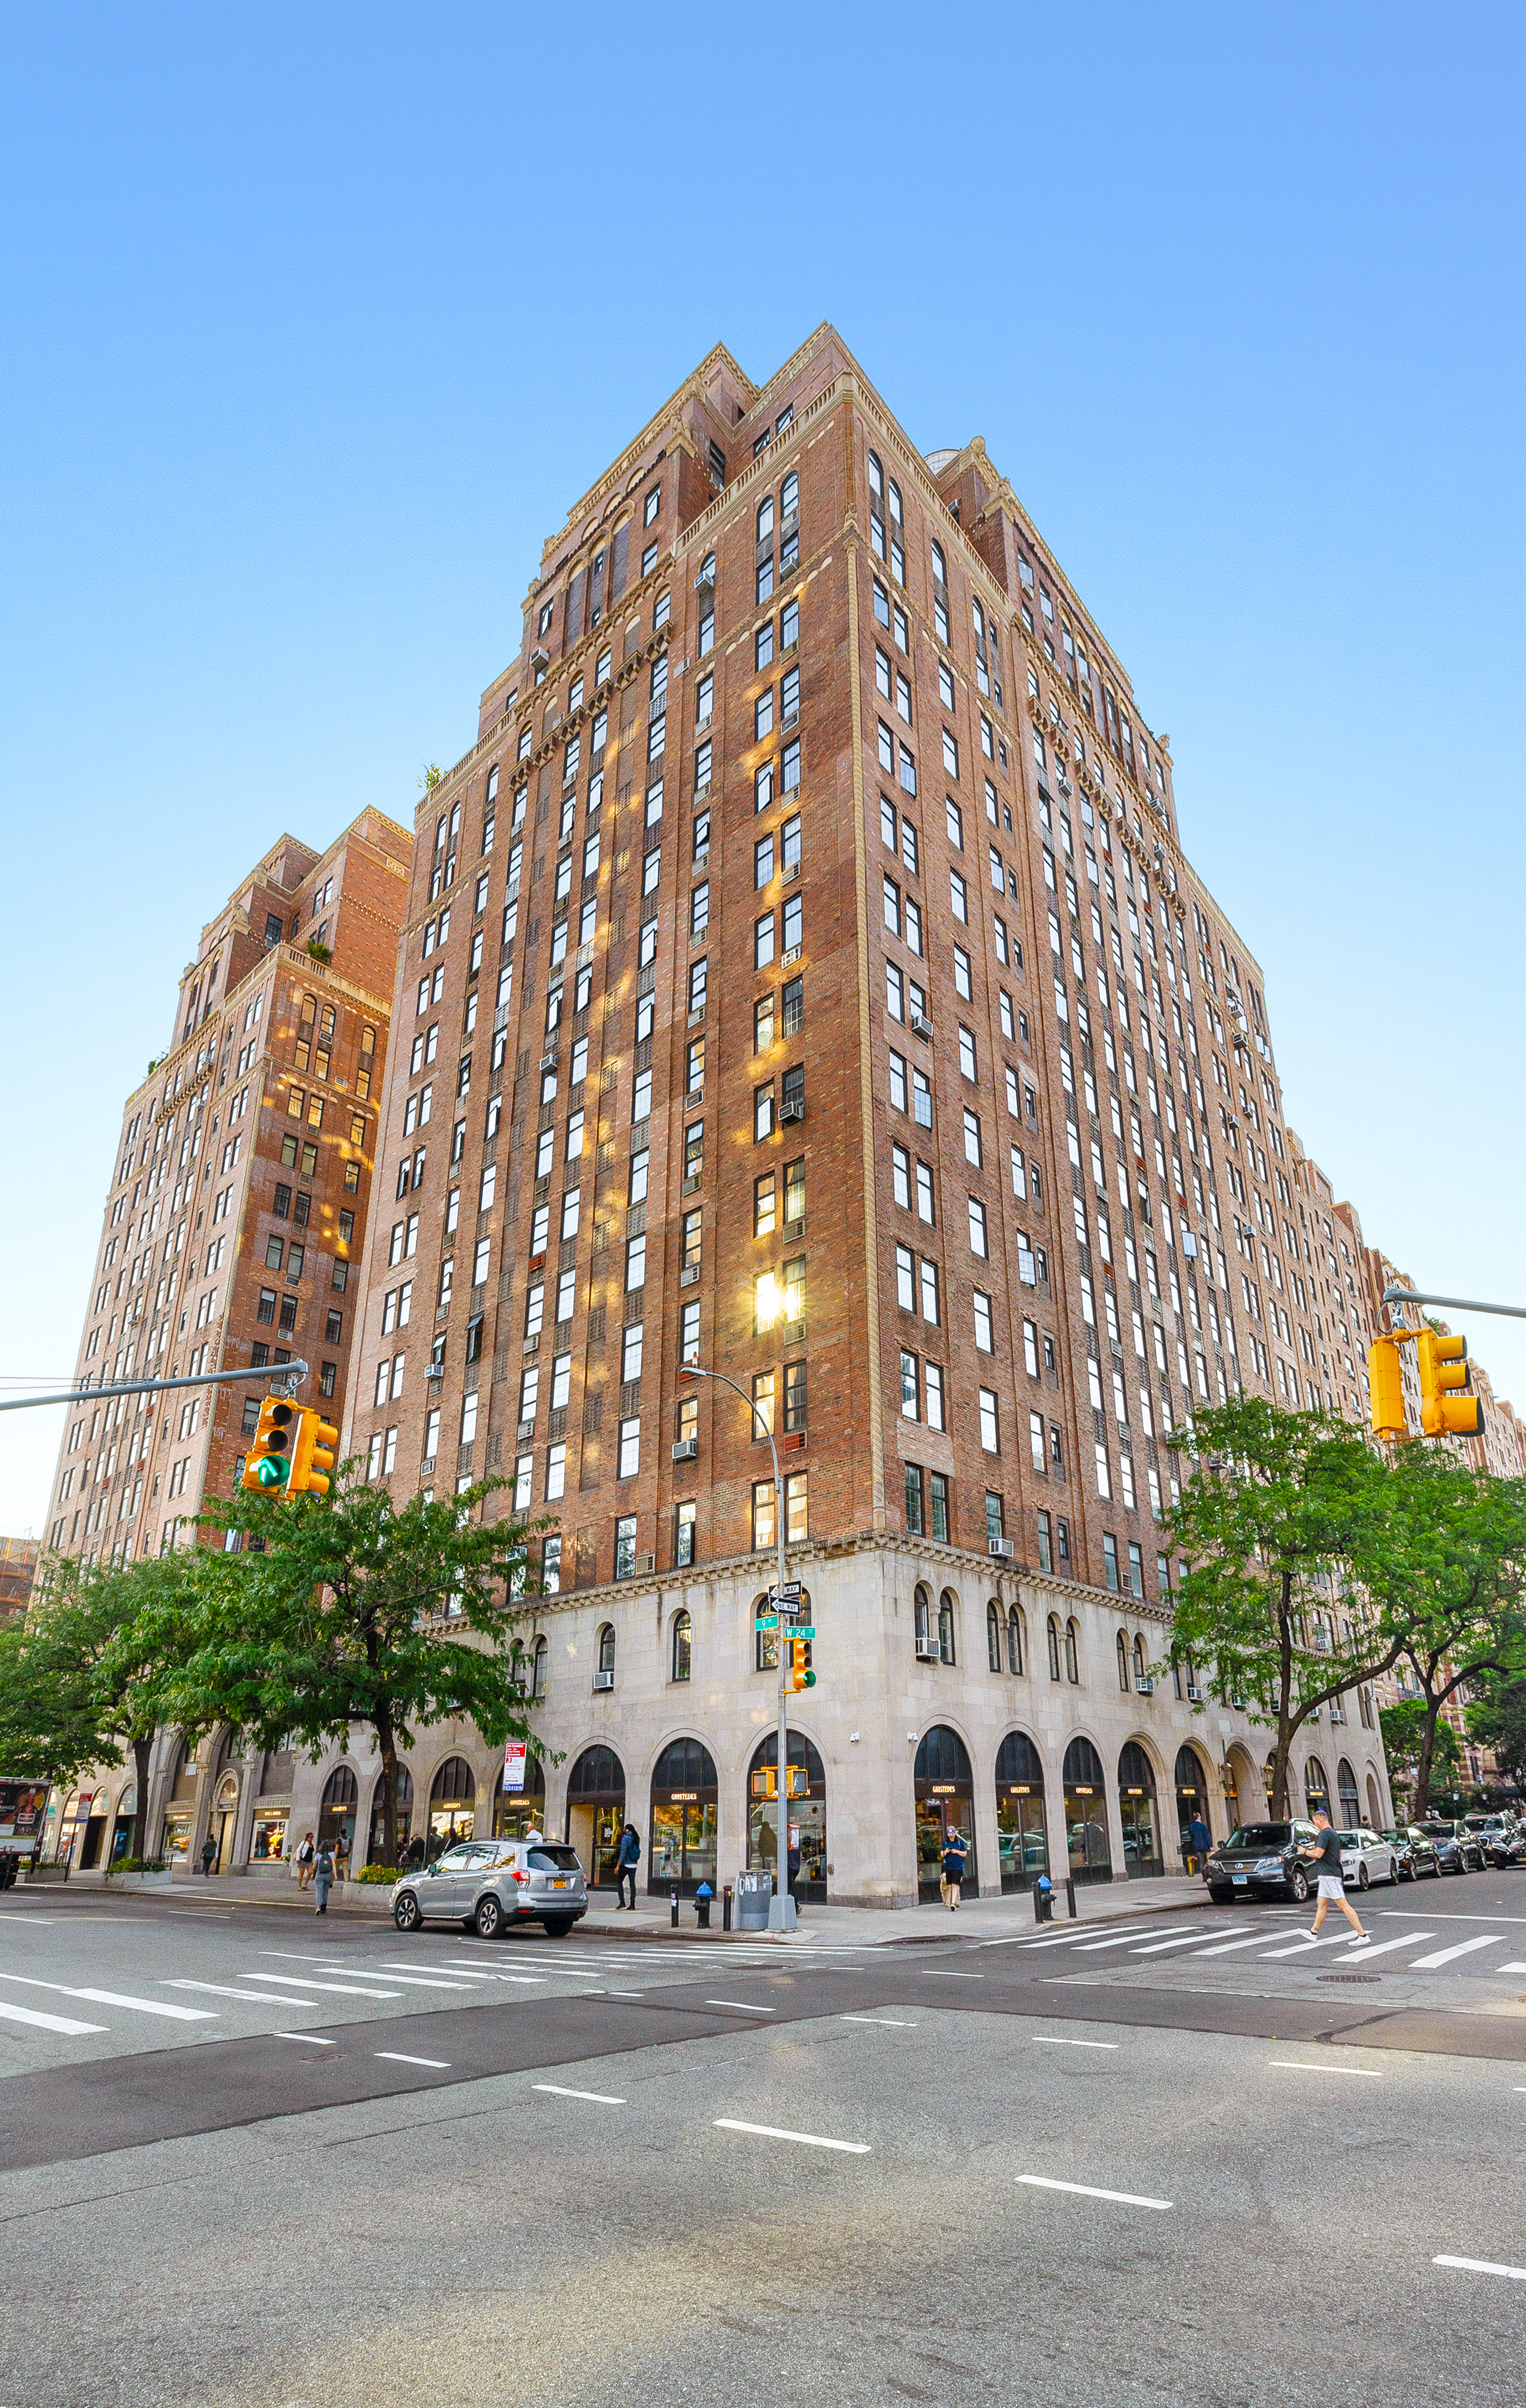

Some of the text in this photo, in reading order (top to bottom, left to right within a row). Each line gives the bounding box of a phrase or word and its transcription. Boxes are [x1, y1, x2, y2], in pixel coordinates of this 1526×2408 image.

[762, 1619, 766, 1628] 9
[786, 1628, 792, 1637] W
[796, 1628, 805, 1637] 24
